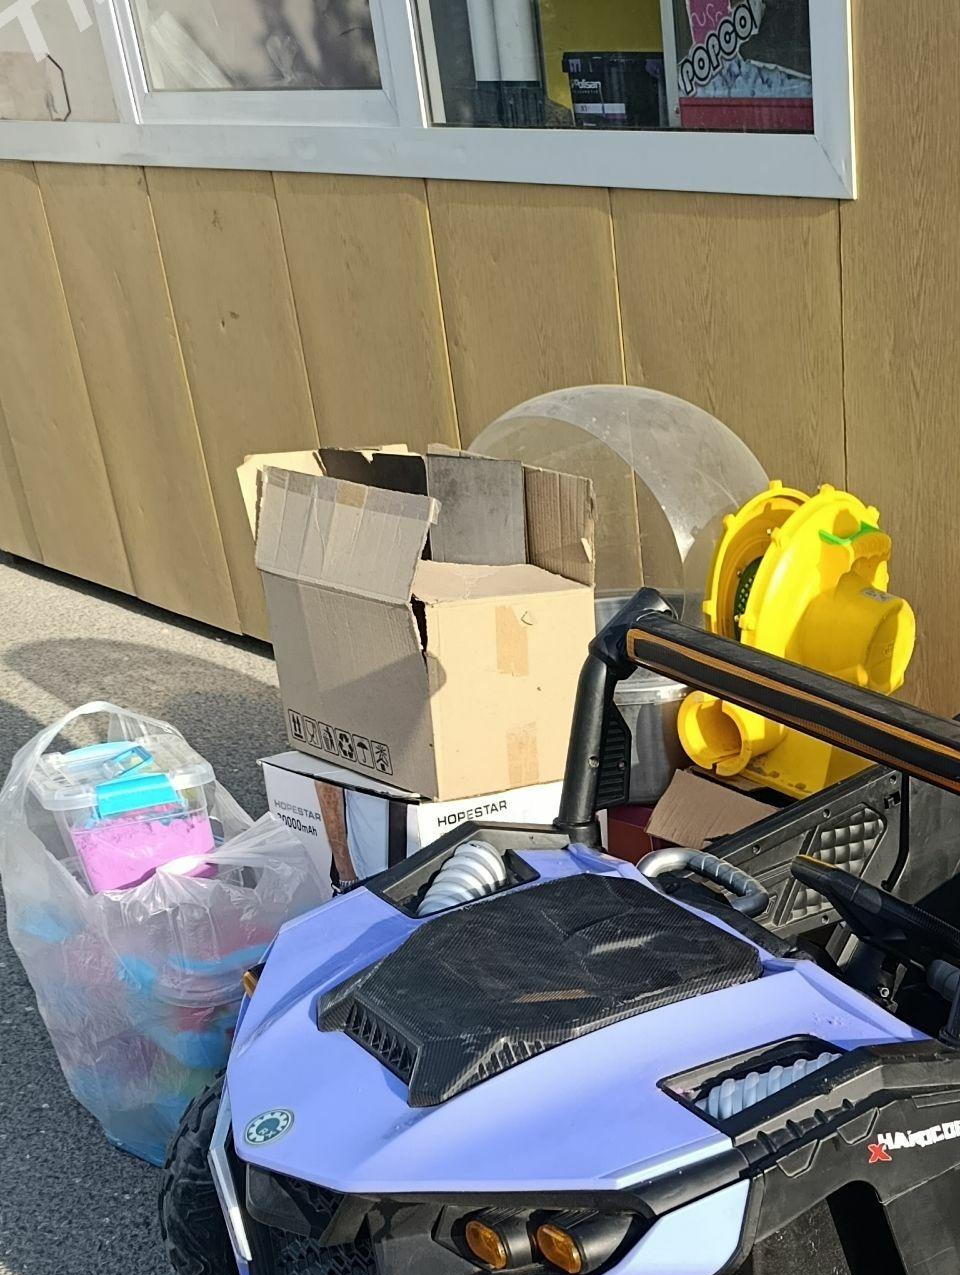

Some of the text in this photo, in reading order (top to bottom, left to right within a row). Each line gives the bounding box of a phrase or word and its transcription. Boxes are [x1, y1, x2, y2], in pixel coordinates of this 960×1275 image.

[681, 0, 758, 96] POPCO
[274, 800, 322, 821] HOPESTAR
[437, 800, 507, 827] HOPESTAR
